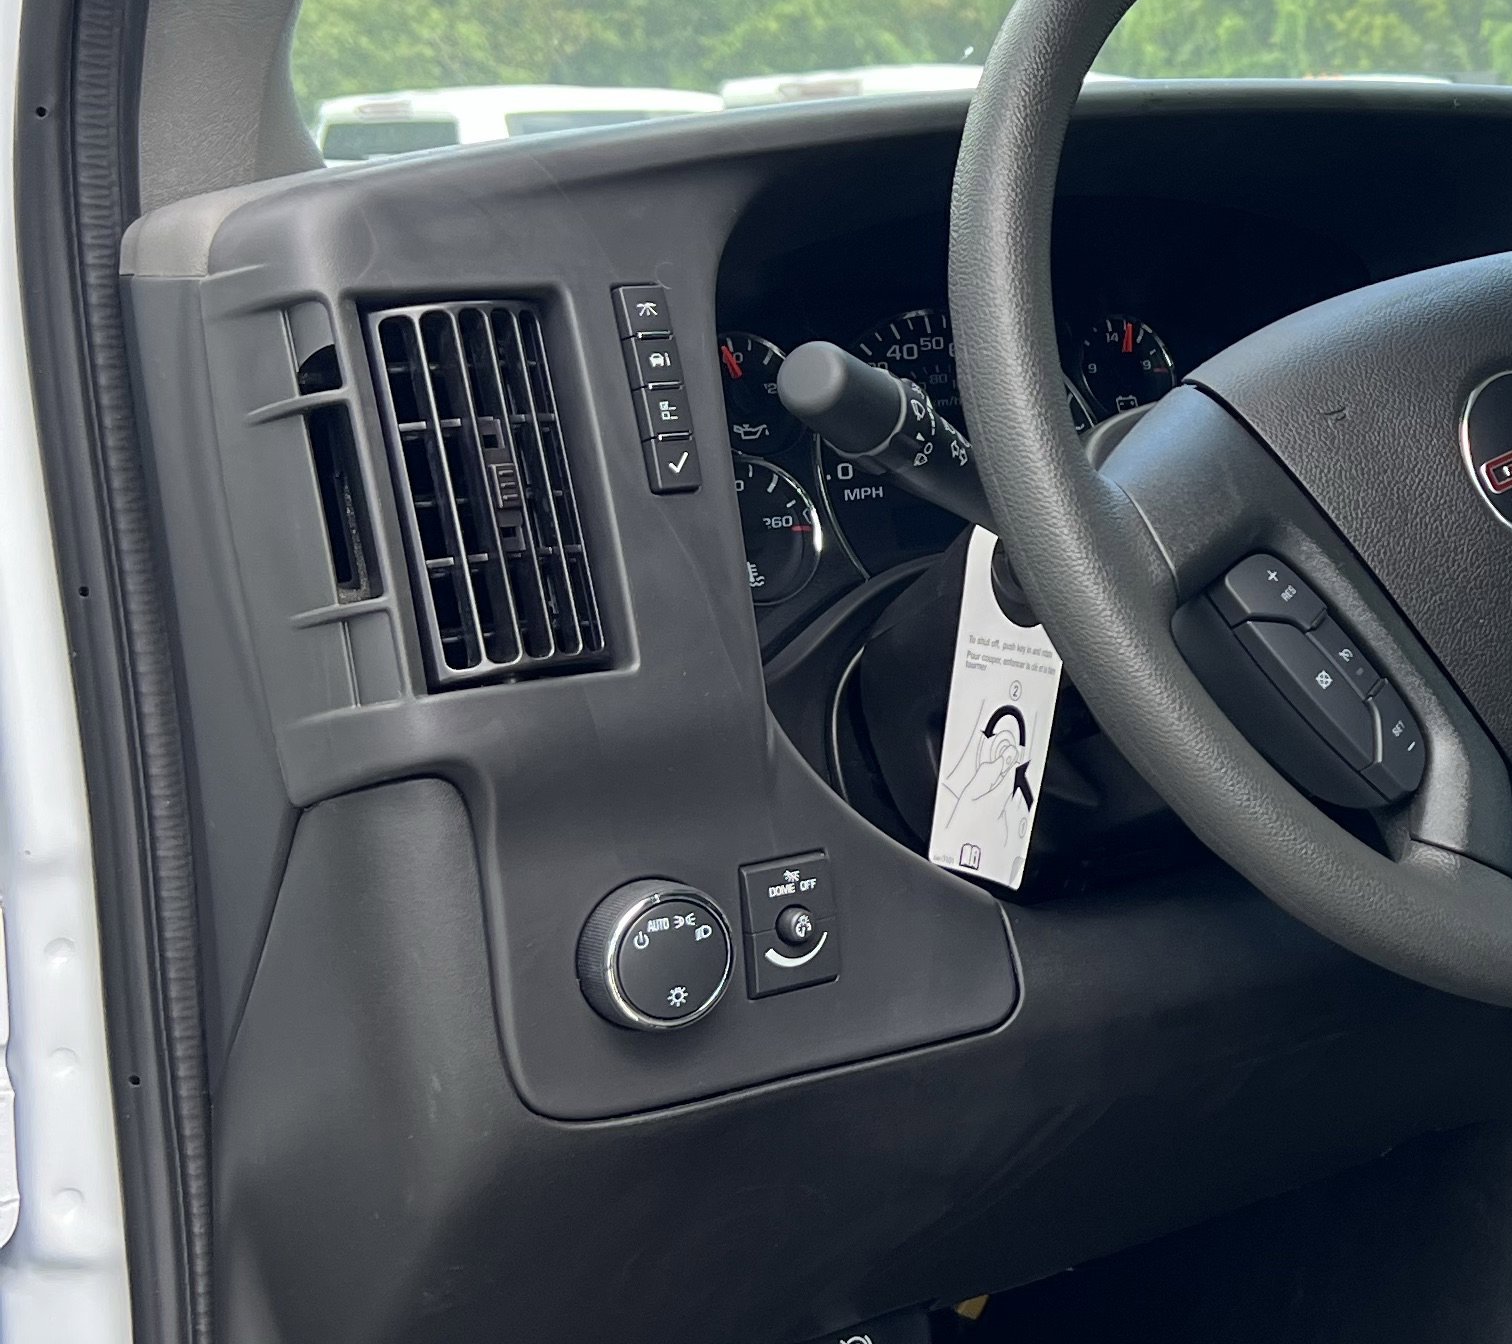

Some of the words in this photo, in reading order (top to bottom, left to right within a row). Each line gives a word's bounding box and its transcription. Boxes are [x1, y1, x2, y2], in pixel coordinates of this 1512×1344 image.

[920, 336, 944, 351] 50
[886, 343, 919, 360] 40
[836, 463, 853, 480] 0
[844, 486, 884, 501] MPH
[1012, 685, 1019, 697] 2
[768, 882, 796, 898] DOME
[799, 878, 817, 892] OFF
[647, 917, 670, 932] AUTO
